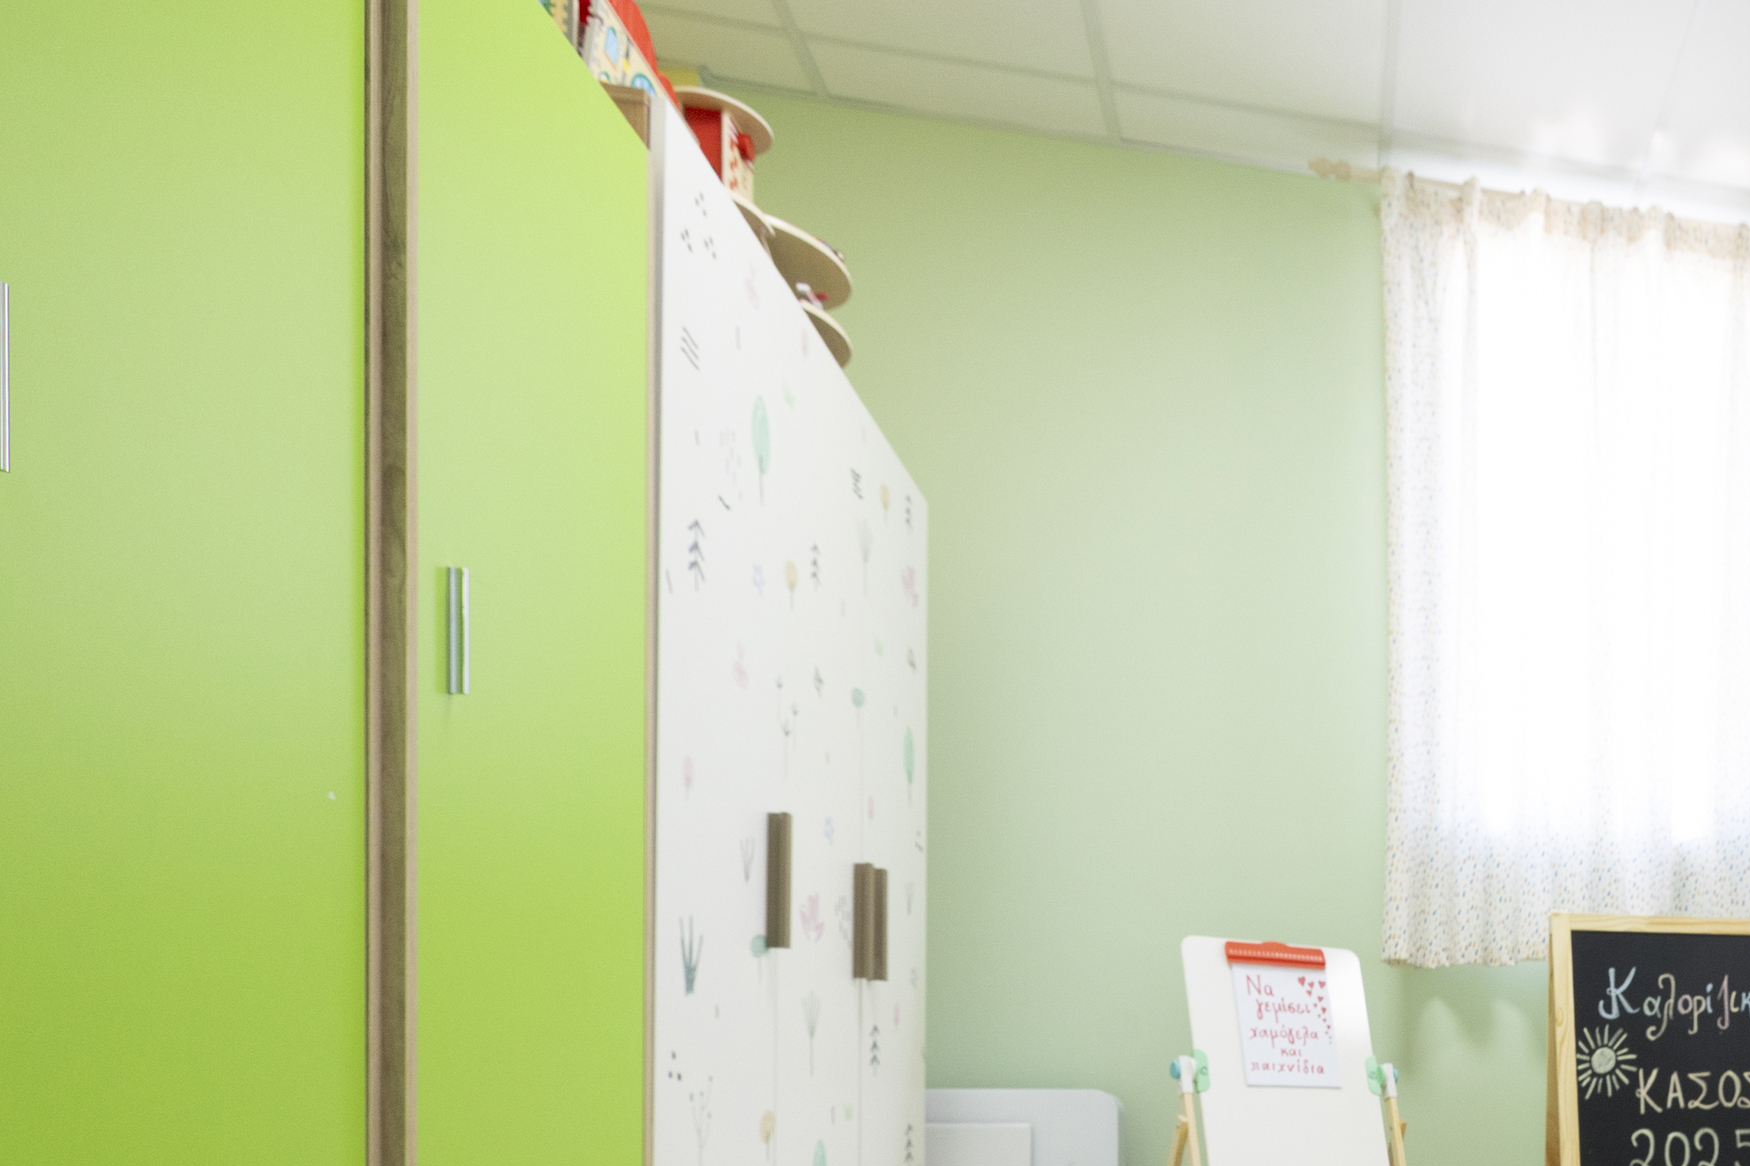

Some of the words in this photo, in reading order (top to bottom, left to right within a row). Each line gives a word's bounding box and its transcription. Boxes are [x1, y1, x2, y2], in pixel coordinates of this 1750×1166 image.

[1246, 974, 1275, 997] Να
[1256, 997, 1311, 1023] γεμίσει
[1248, 1024, 1319, 1048] χαμόγελα
[1280, 1047, 1303, 1057] και
[1250, 1058, 1325, 1075] παιχνίδια
